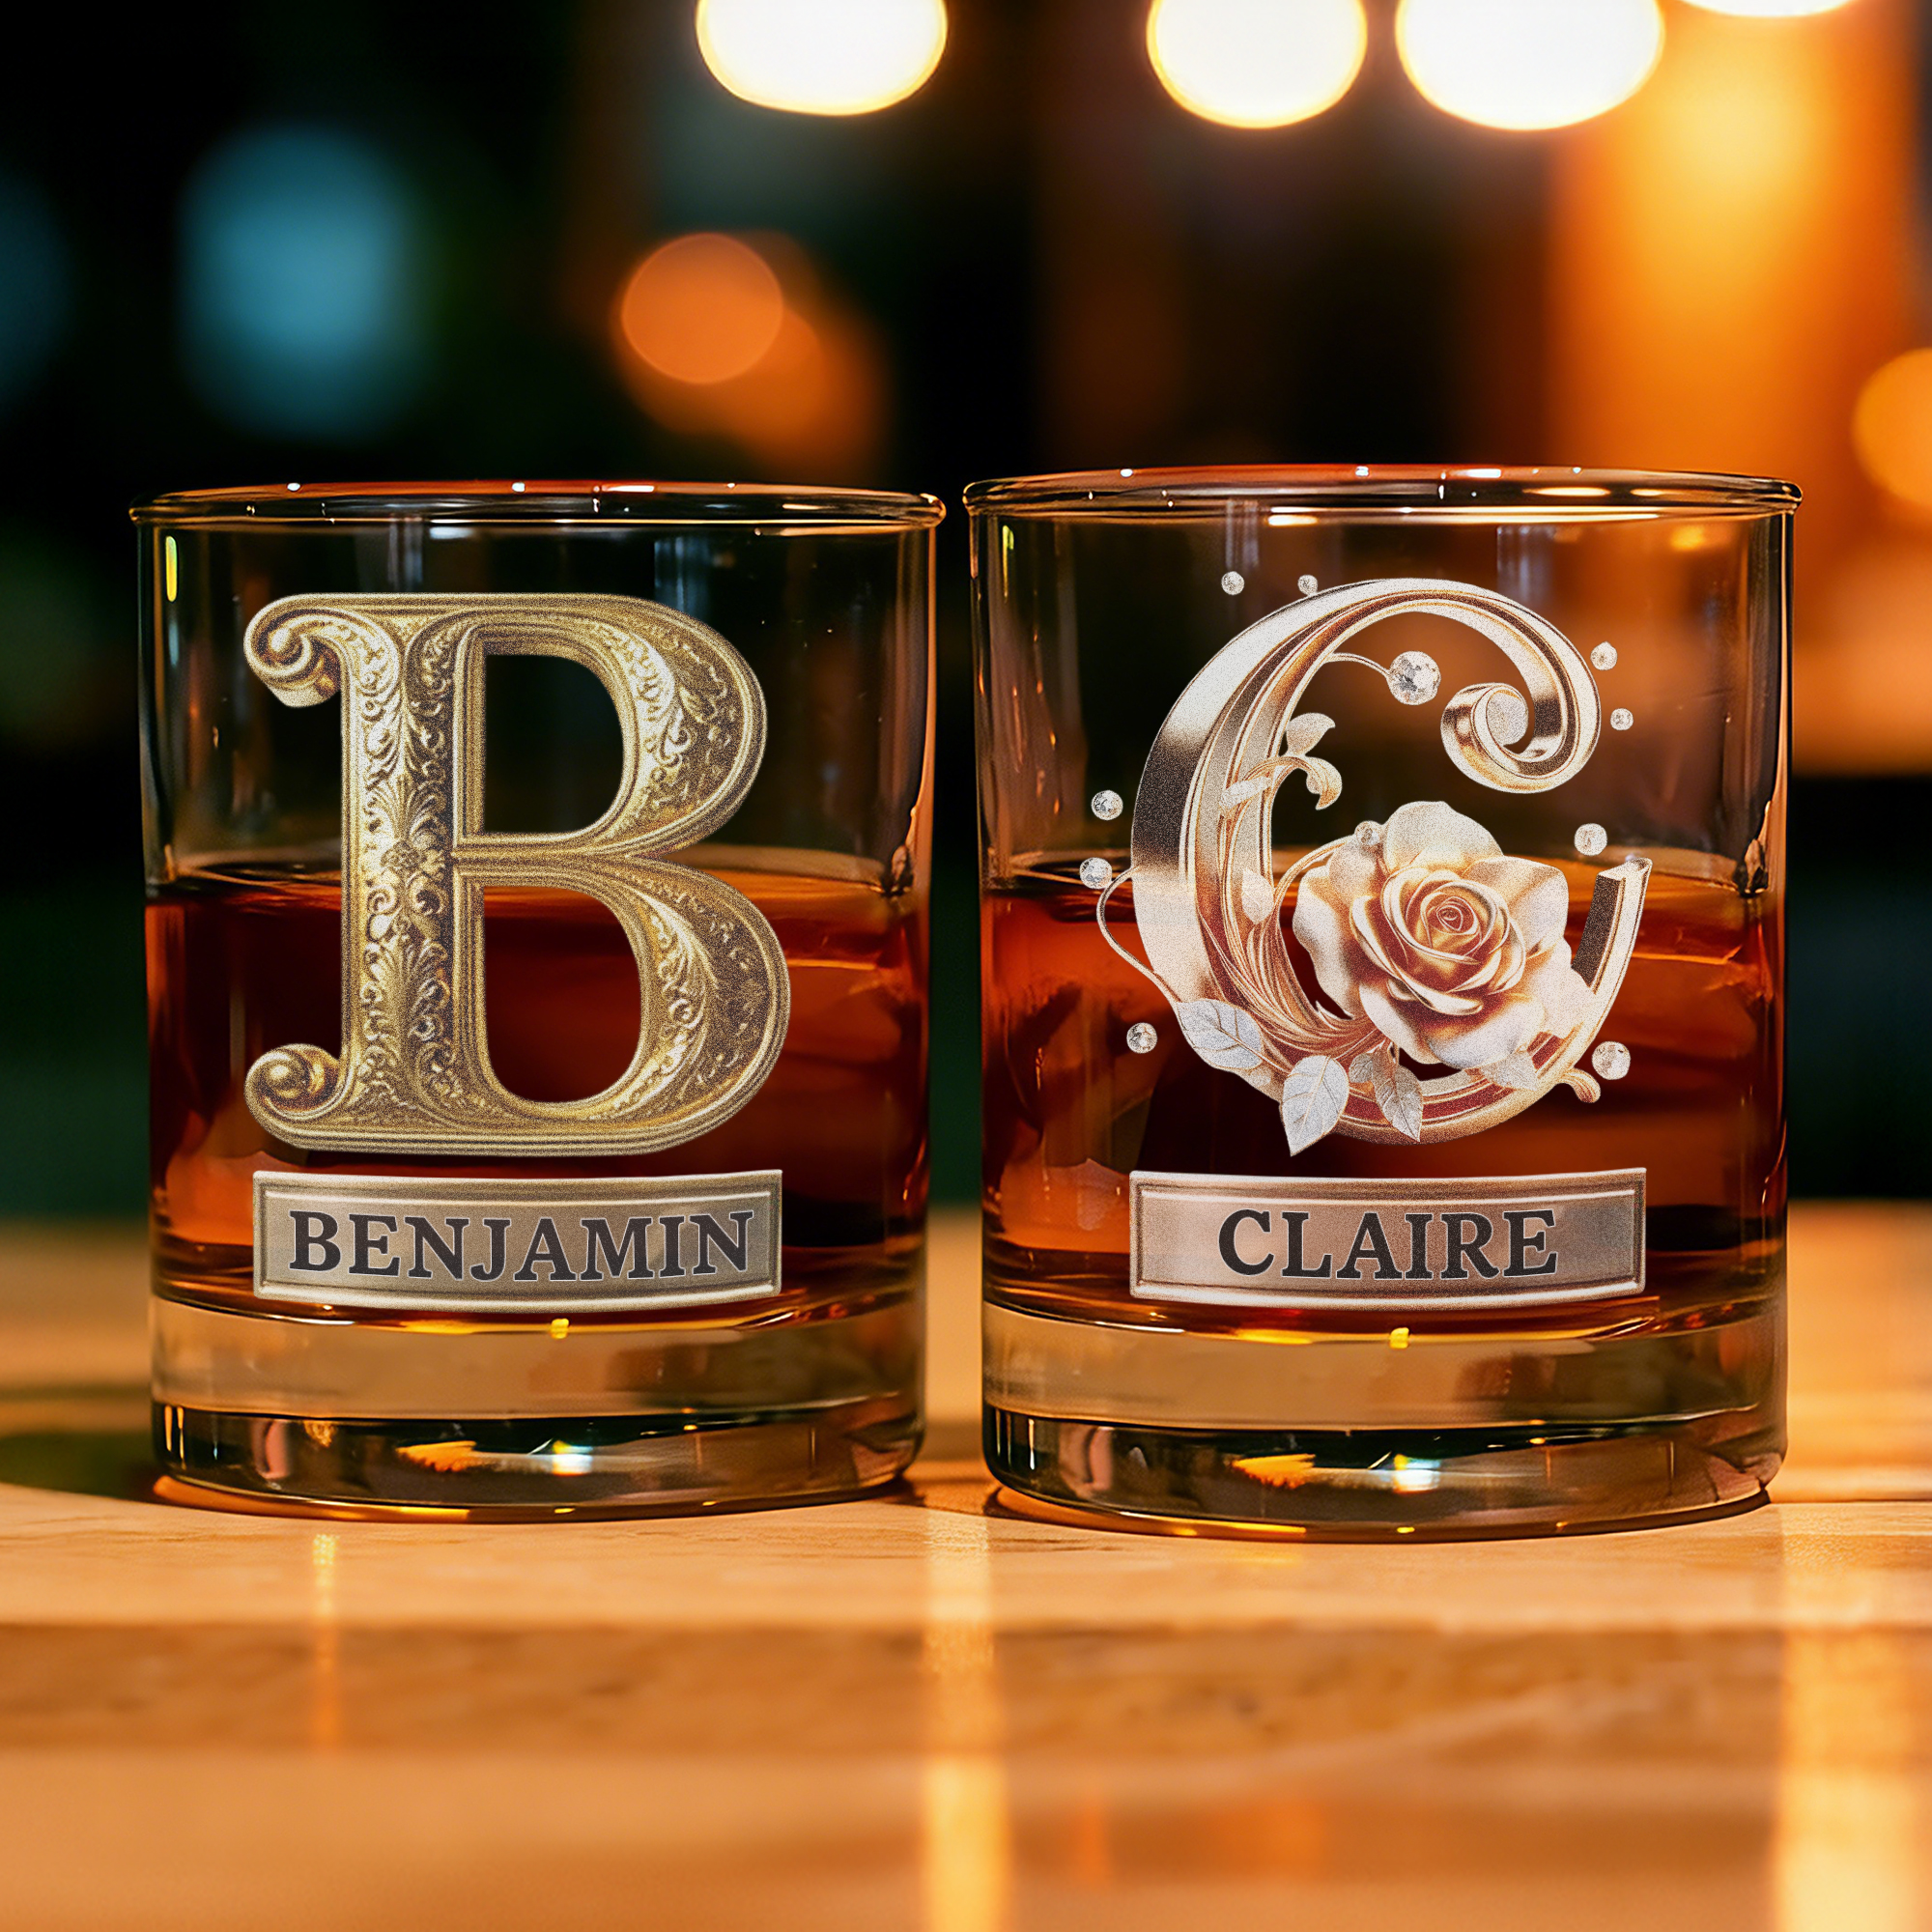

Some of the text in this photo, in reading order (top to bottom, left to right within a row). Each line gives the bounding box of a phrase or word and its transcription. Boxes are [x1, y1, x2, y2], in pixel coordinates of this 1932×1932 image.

[243, 592, 790, 1156] B
[1129, 577, 1651, 1148] C
[290, 1209, 753, 1281] BENJAMIN
[1218, 1208, 1559, 1279] CLAIRE
